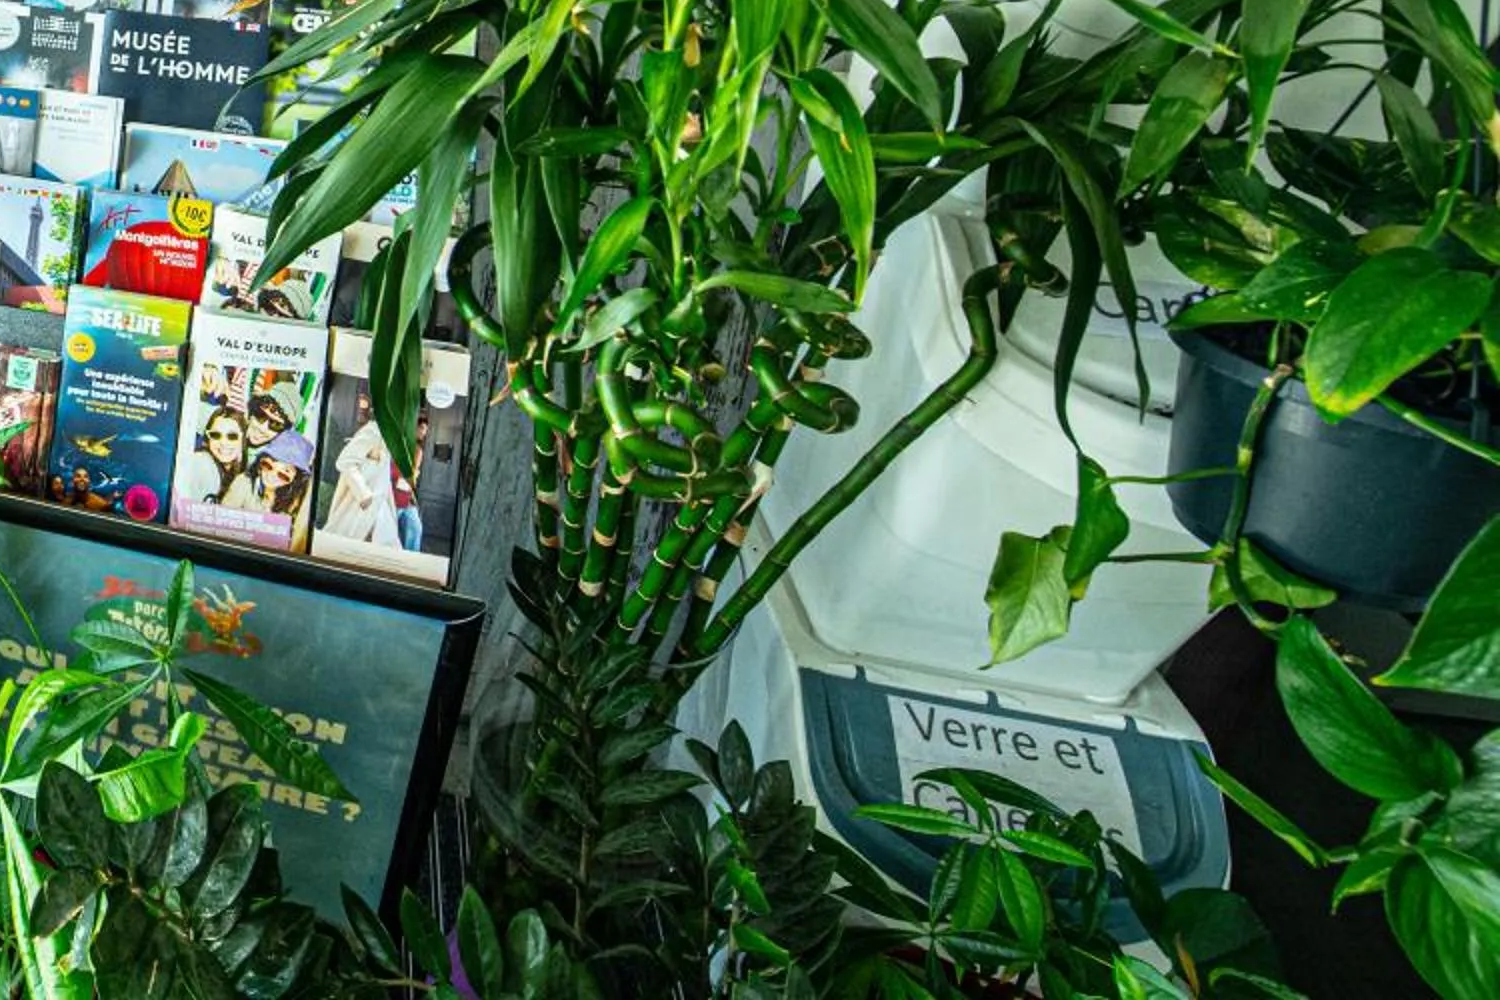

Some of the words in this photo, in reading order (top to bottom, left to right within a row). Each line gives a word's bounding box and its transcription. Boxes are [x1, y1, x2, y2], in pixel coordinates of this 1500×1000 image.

[112, 29, 191, 55] MUSÉE
[110, 53, 129, 68] DE
[137, 56, 250, 85] L'HOMME
[231, 231, 256, 247] VAL
[90, 308, 123, 329] SEA
[132, 315, 163, 337] LIFE
[217, 336, 241, 351] VAL
[243, 341, 308, 359] D'EUROPE
[134, 601, 167, 620] parc
[904, 702, 1040, 762] Verre
[1055, 736, 1104, 775] et
